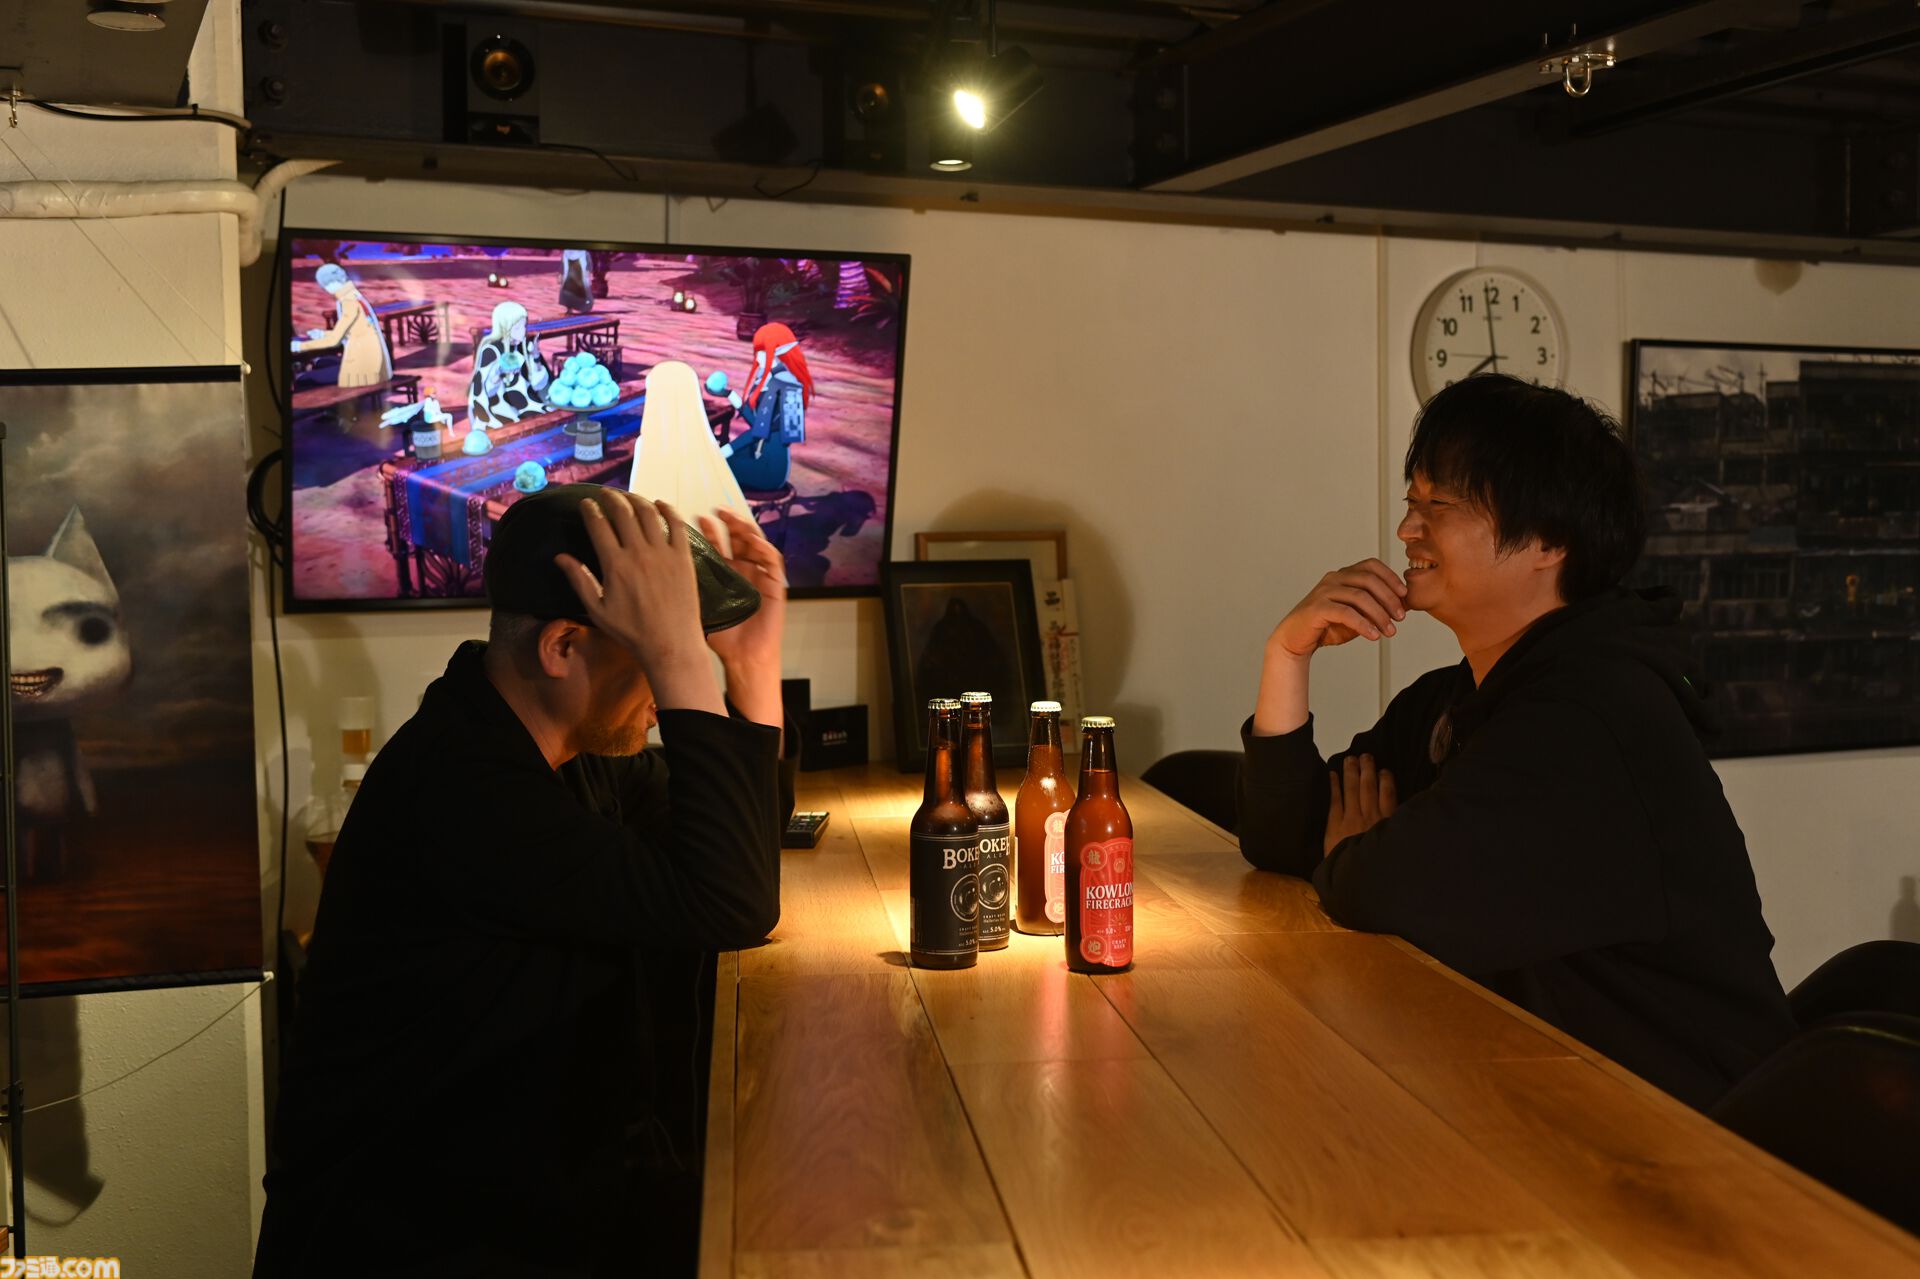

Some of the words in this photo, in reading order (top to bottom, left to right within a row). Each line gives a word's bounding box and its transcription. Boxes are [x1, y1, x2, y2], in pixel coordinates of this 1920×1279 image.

[1460, 295, 1473, 313] 11
[1512, 295, 1519, 313] 1
[1442, 318, 1458, 336] 10
[1530, 317, 1541, 334] 2
[1436, 349, 1447, 367] 9
[1537, 347, 1548, 365] 3
[979, 836, 1010, 856] OKEH
[942, 846, 980, 870] BOKE
